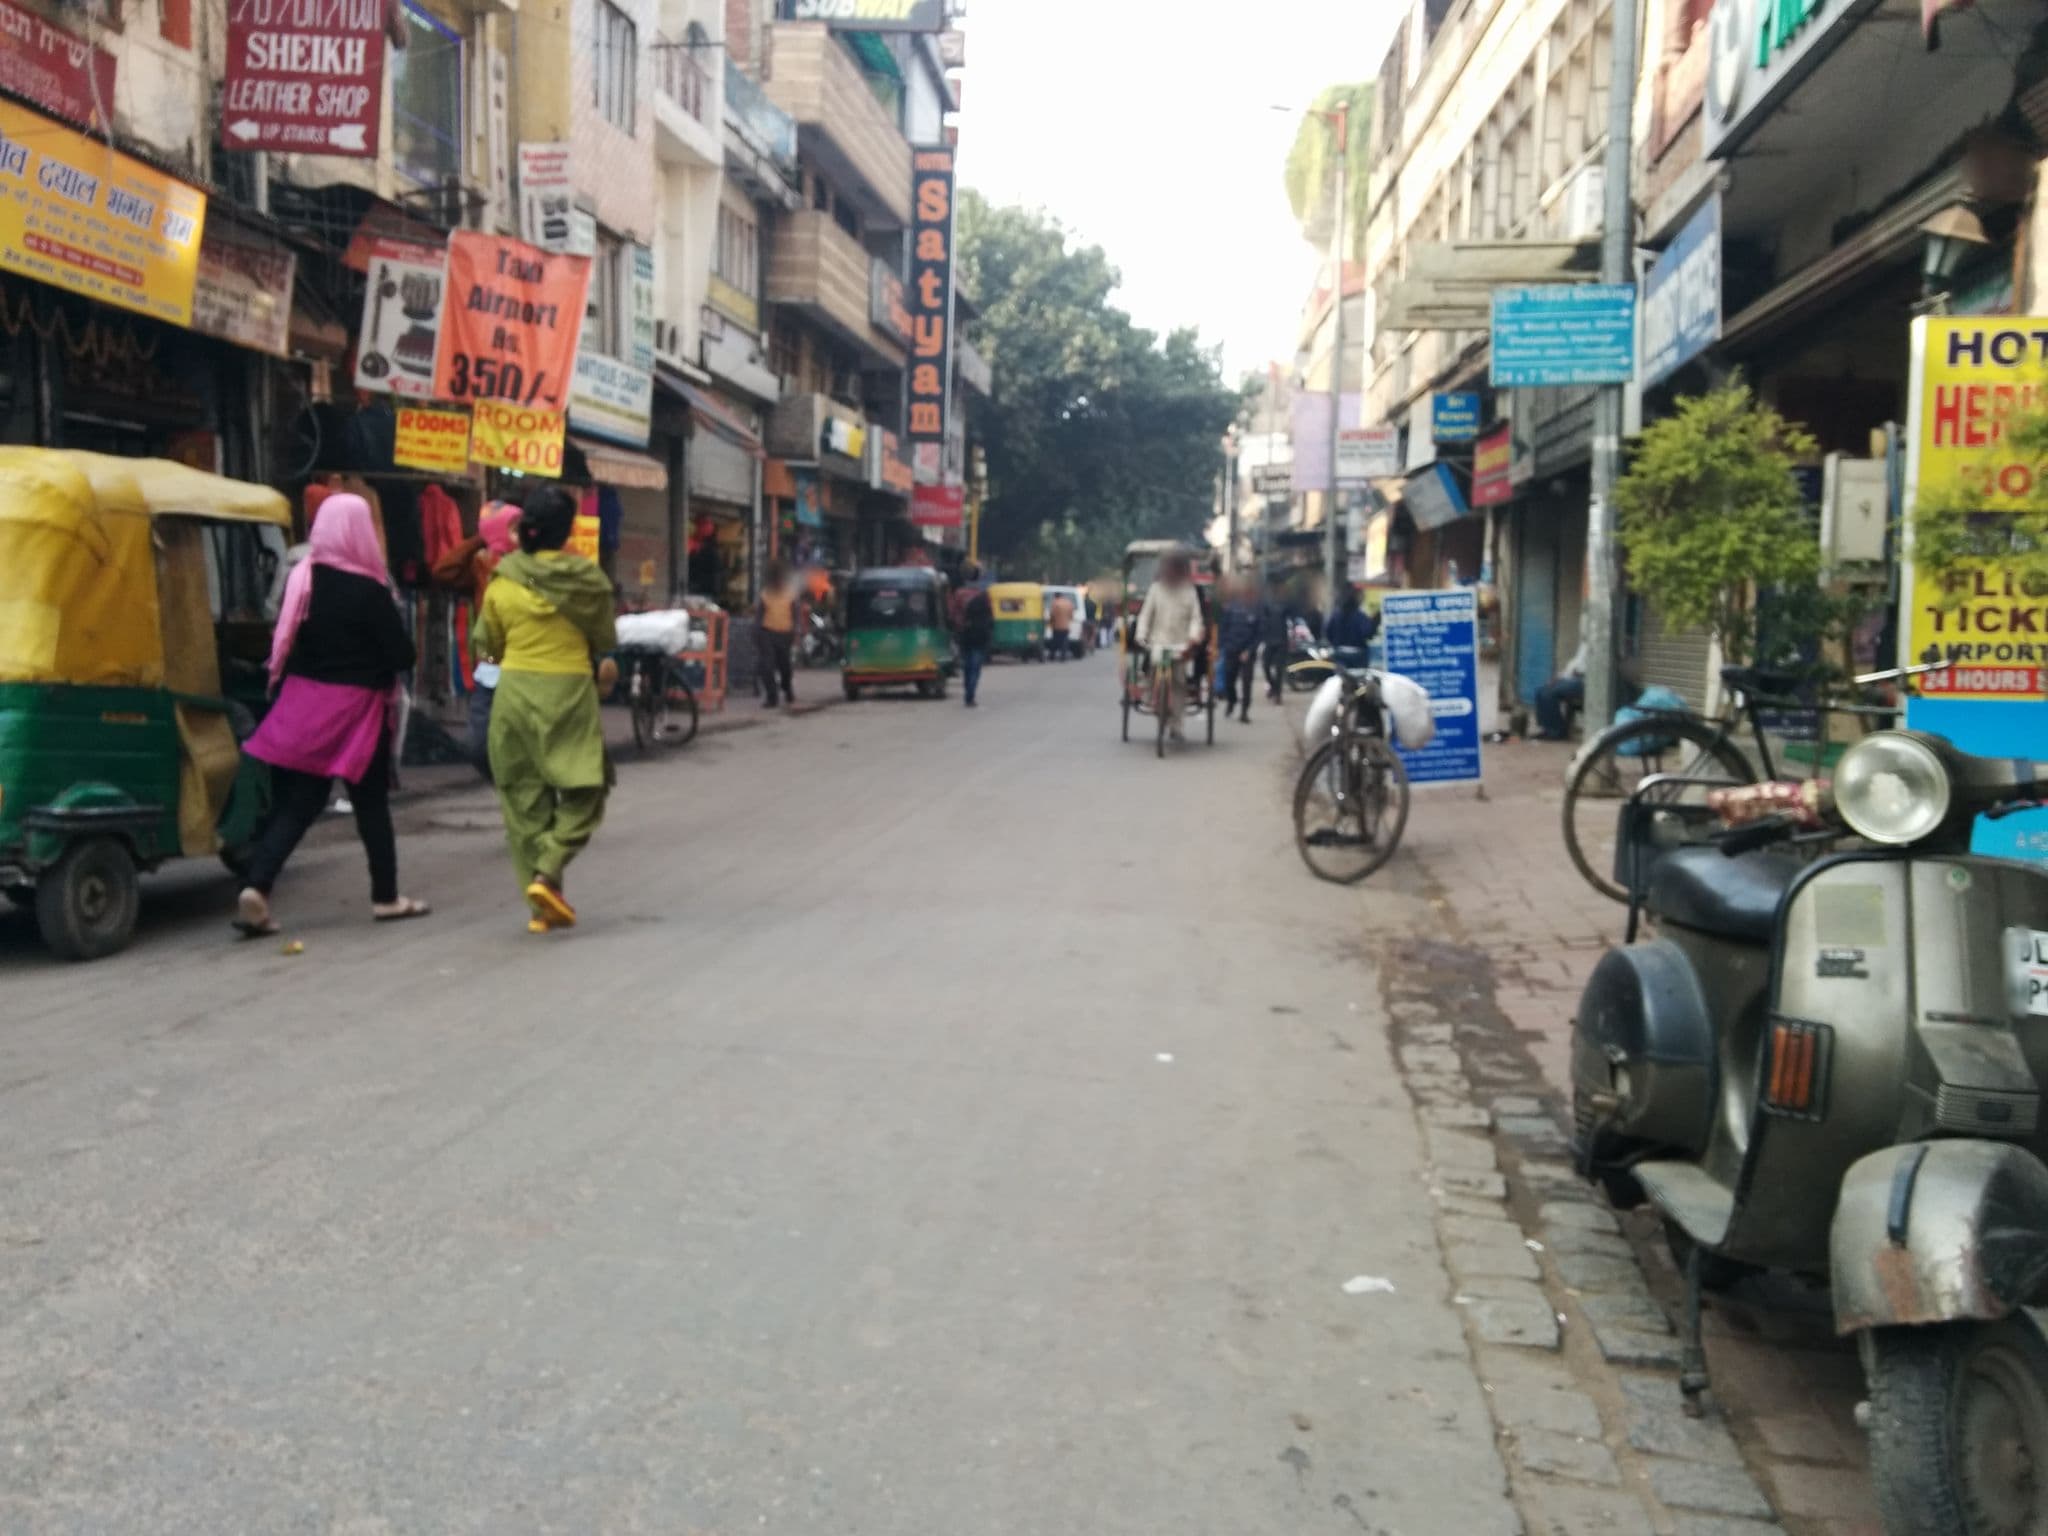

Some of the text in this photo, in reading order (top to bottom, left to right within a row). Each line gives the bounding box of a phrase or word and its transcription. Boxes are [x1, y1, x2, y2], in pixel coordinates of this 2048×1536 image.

[245, 30, 367, 76] SHEIKH
[228, 78, 371, 119] LEATHER SHOP
[497, 247, 544, 284] Taxi
[467, 284, 558, 329] Airport
[908, 177, 950, 434] Satyam
[399, 409, 467, 436] ROOMS
[477, 403, 563, 433] ROOM
[503, 437, 562, 469] 400
[1954, 669, 2029, 692] HOURS
